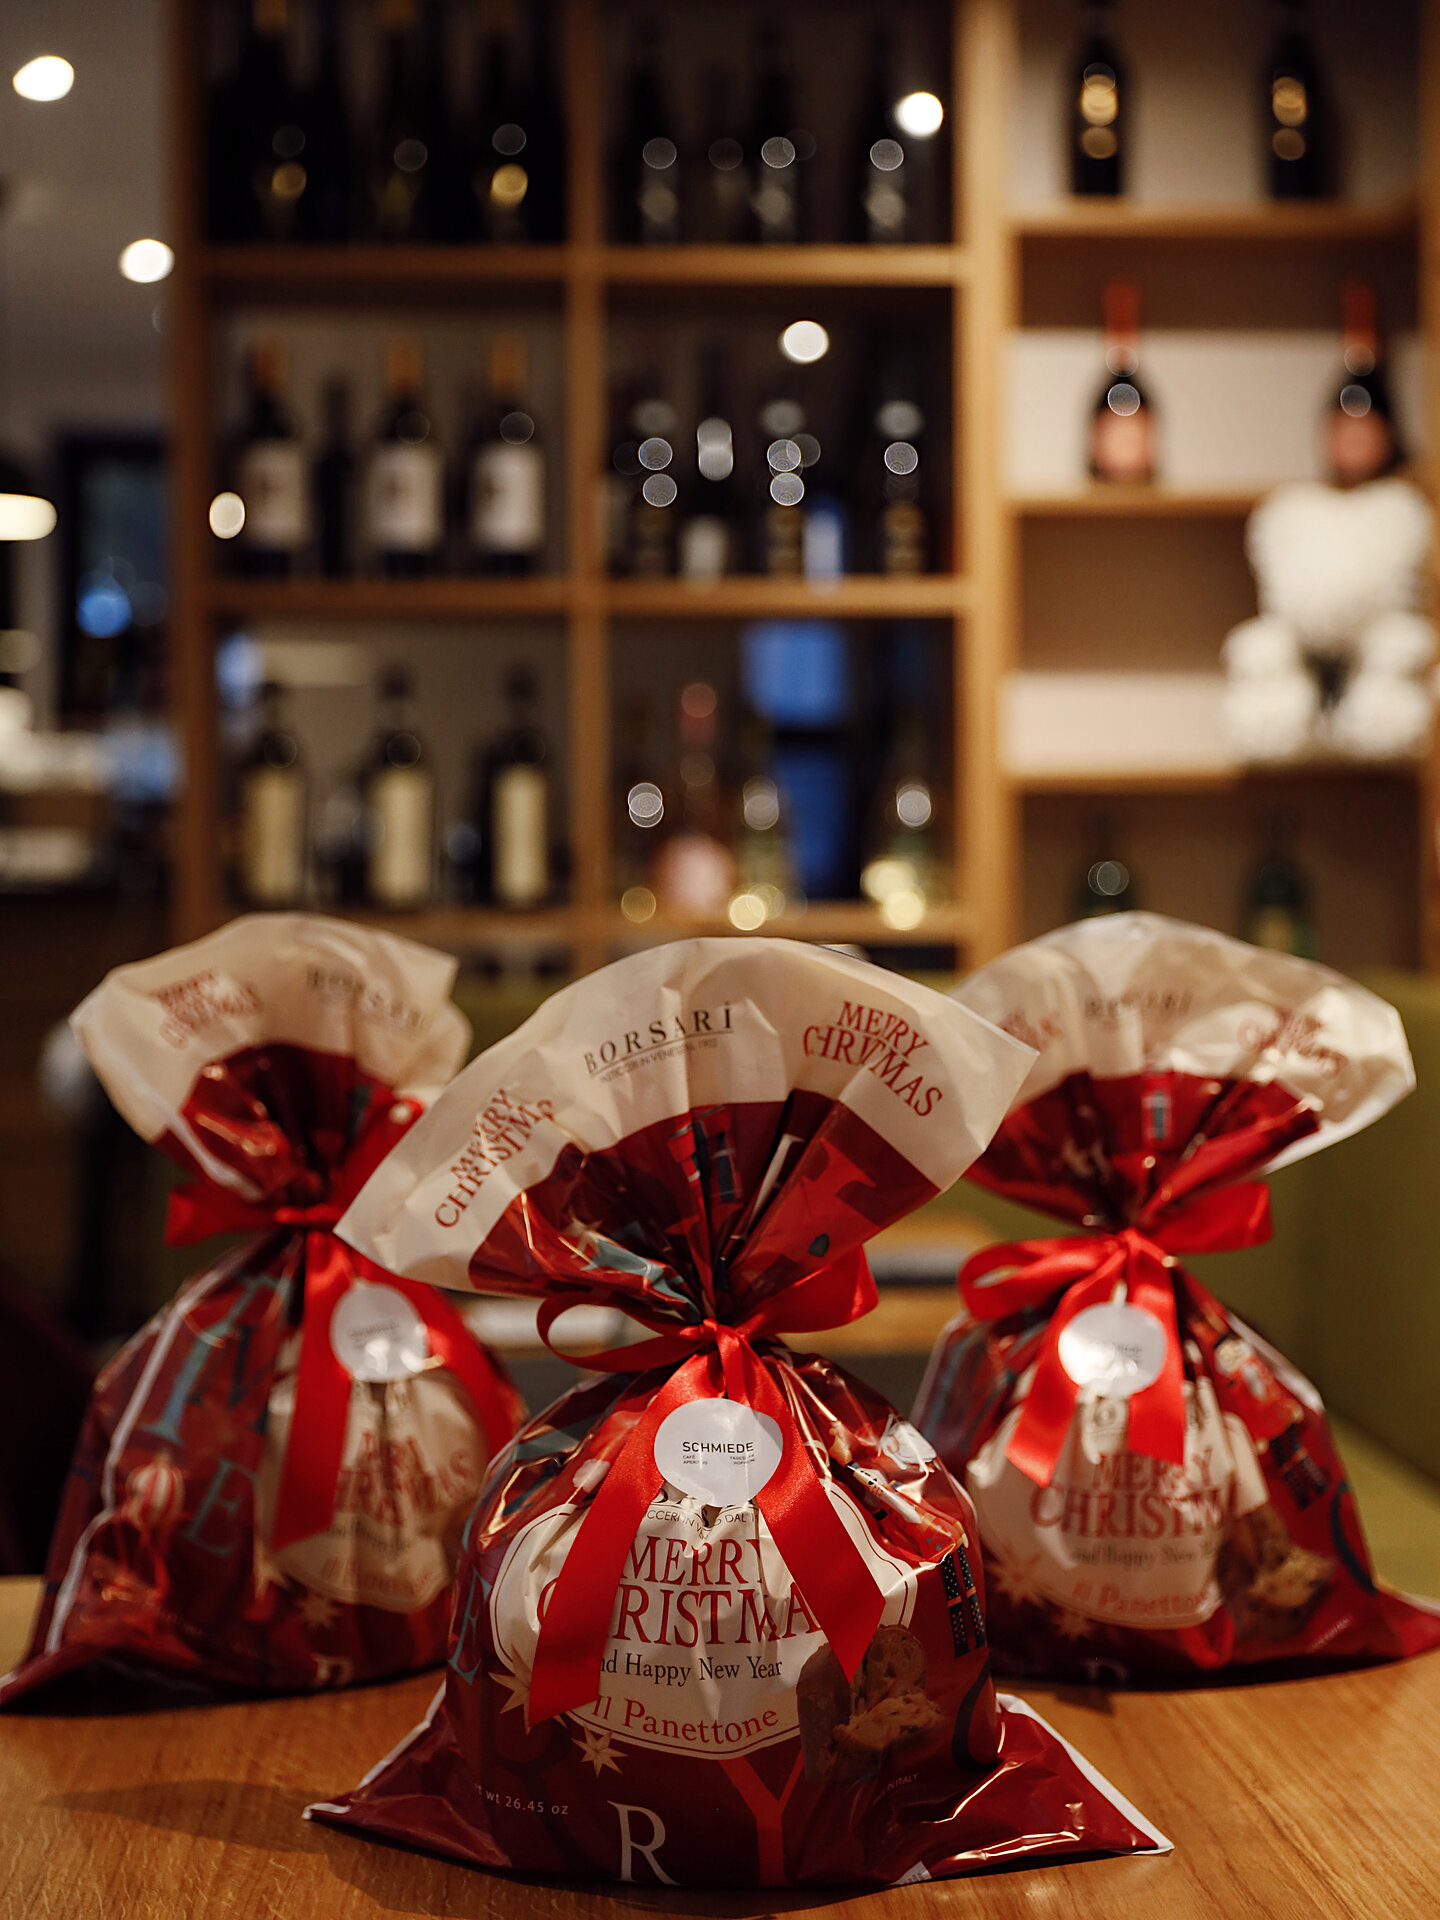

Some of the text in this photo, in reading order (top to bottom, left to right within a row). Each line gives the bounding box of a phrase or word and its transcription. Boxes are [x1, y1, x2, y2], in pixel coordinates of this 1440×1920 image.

[682, 1441, 754, 1454] SCHMIEDE
[600, 1649, 783, 1688] nd Happy New Year
[621, 1697, 780, 1745] Panettone
[504, 1795, 544, 1813] 26.45
[551, 1805, 568, 1815] oz
[607, 1800, 681, 1886] R
